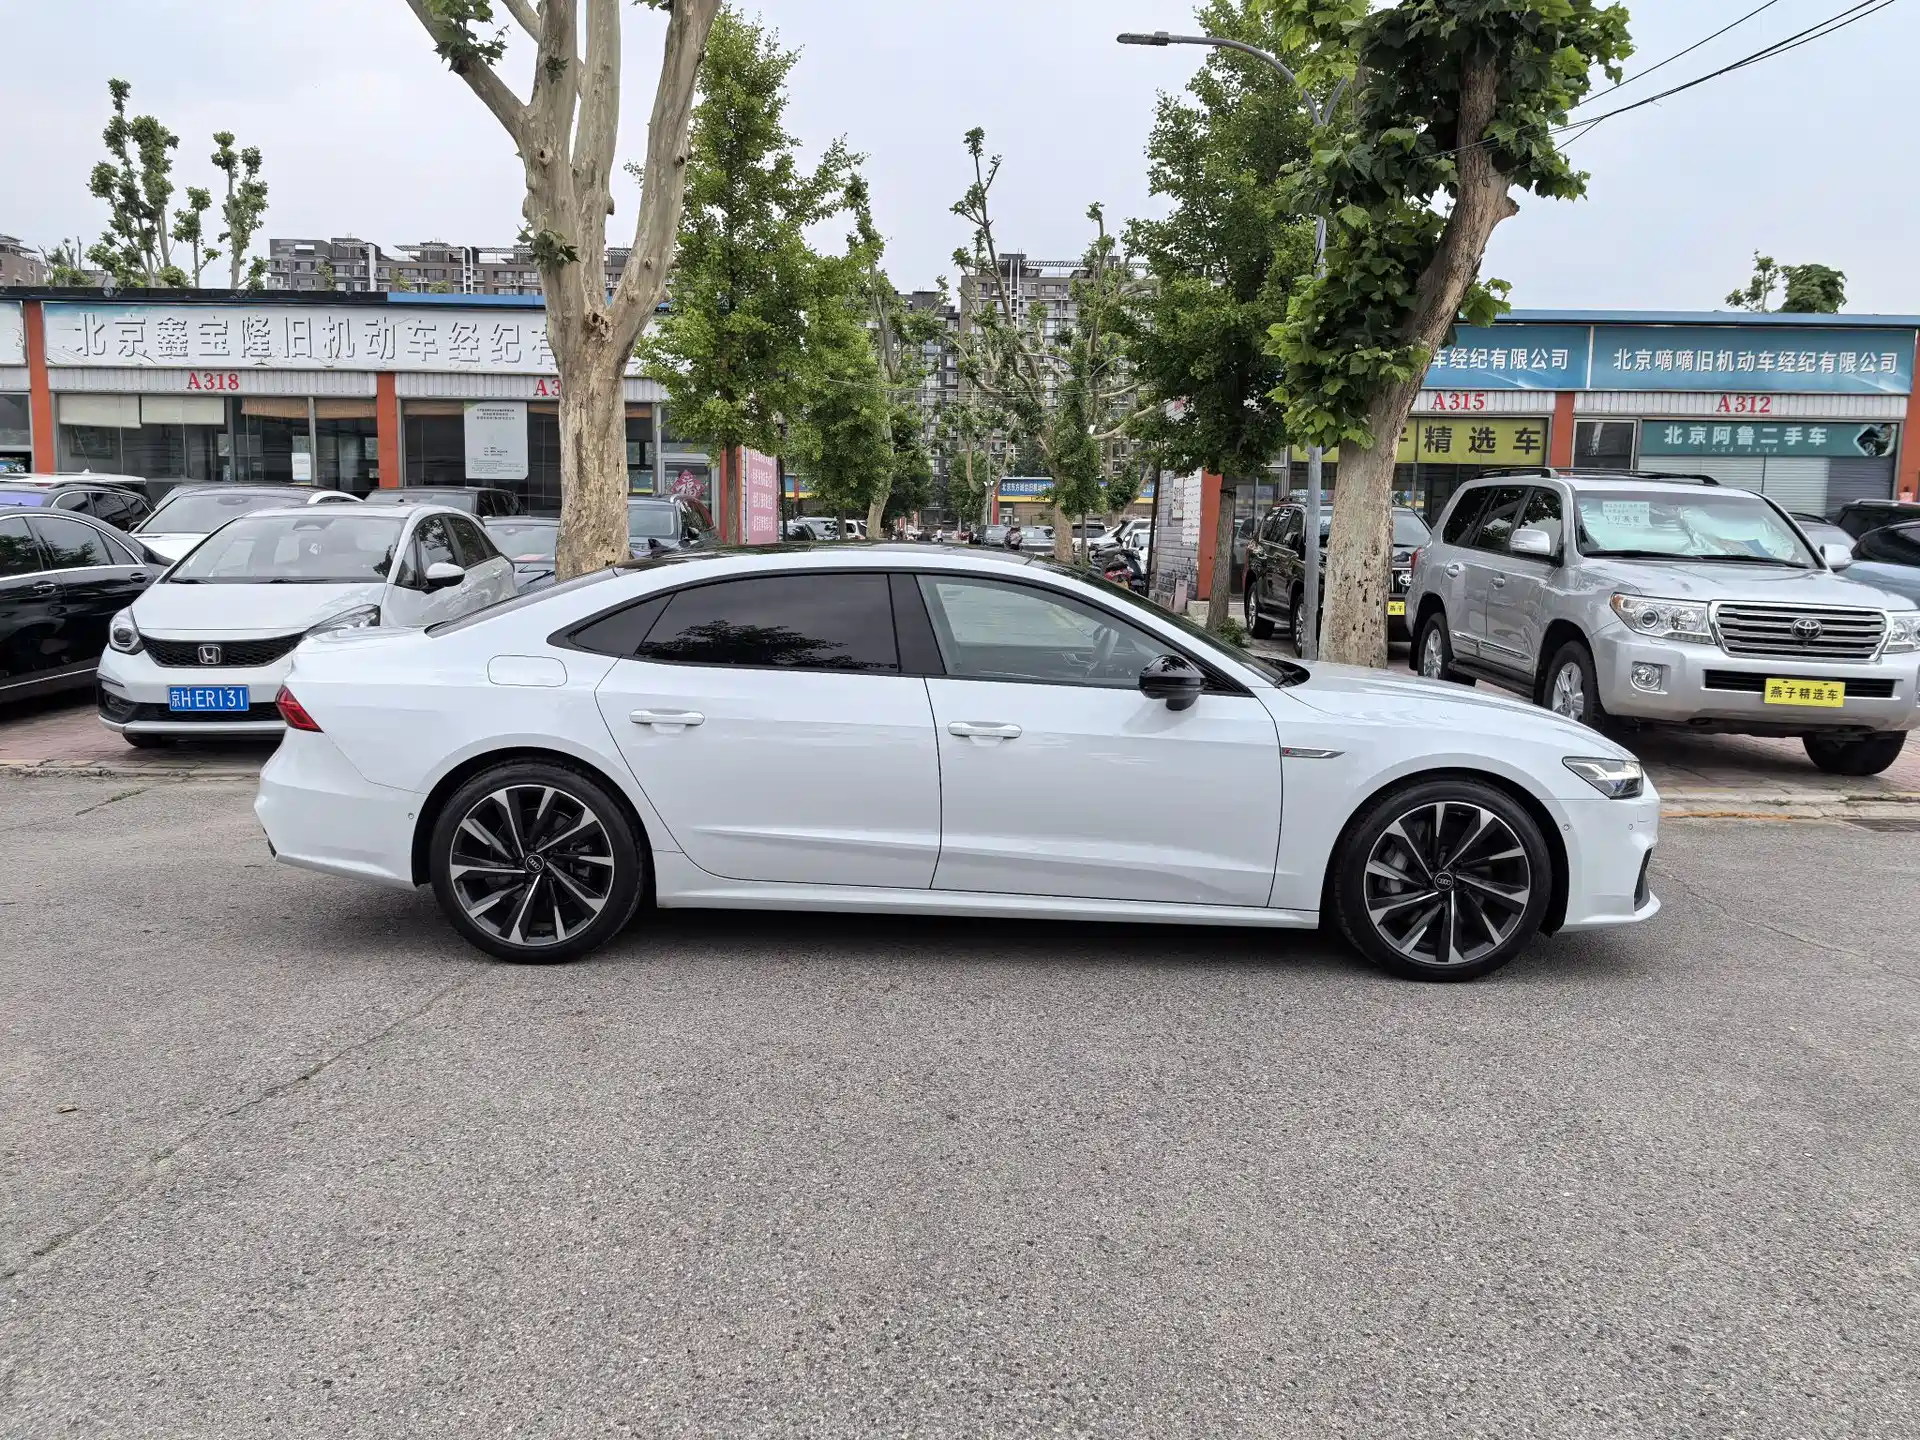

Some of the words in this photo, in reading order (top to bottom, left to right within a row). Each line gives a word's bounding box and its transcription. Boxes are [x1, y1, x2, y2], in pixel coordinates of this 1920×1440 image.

[74, 313, 556, 369] 北京鑫宝隆旧机动车经纪有
[1613, 348, 1898, 375] 北京嘀嘀旧机动车经纪有限公司
[186, 371, 240, 391] A318
[533, 379, 561, 397] A3
[1430, 392, 1486, 411] A315
[1716, 394, 1772, 414] A312
[1399, 425, 1542, 456] 精选车
[1663, 424, 1828, 447] 北京阿鲁二手车
[1770, 685, 1839, 702] 燕子精选车
